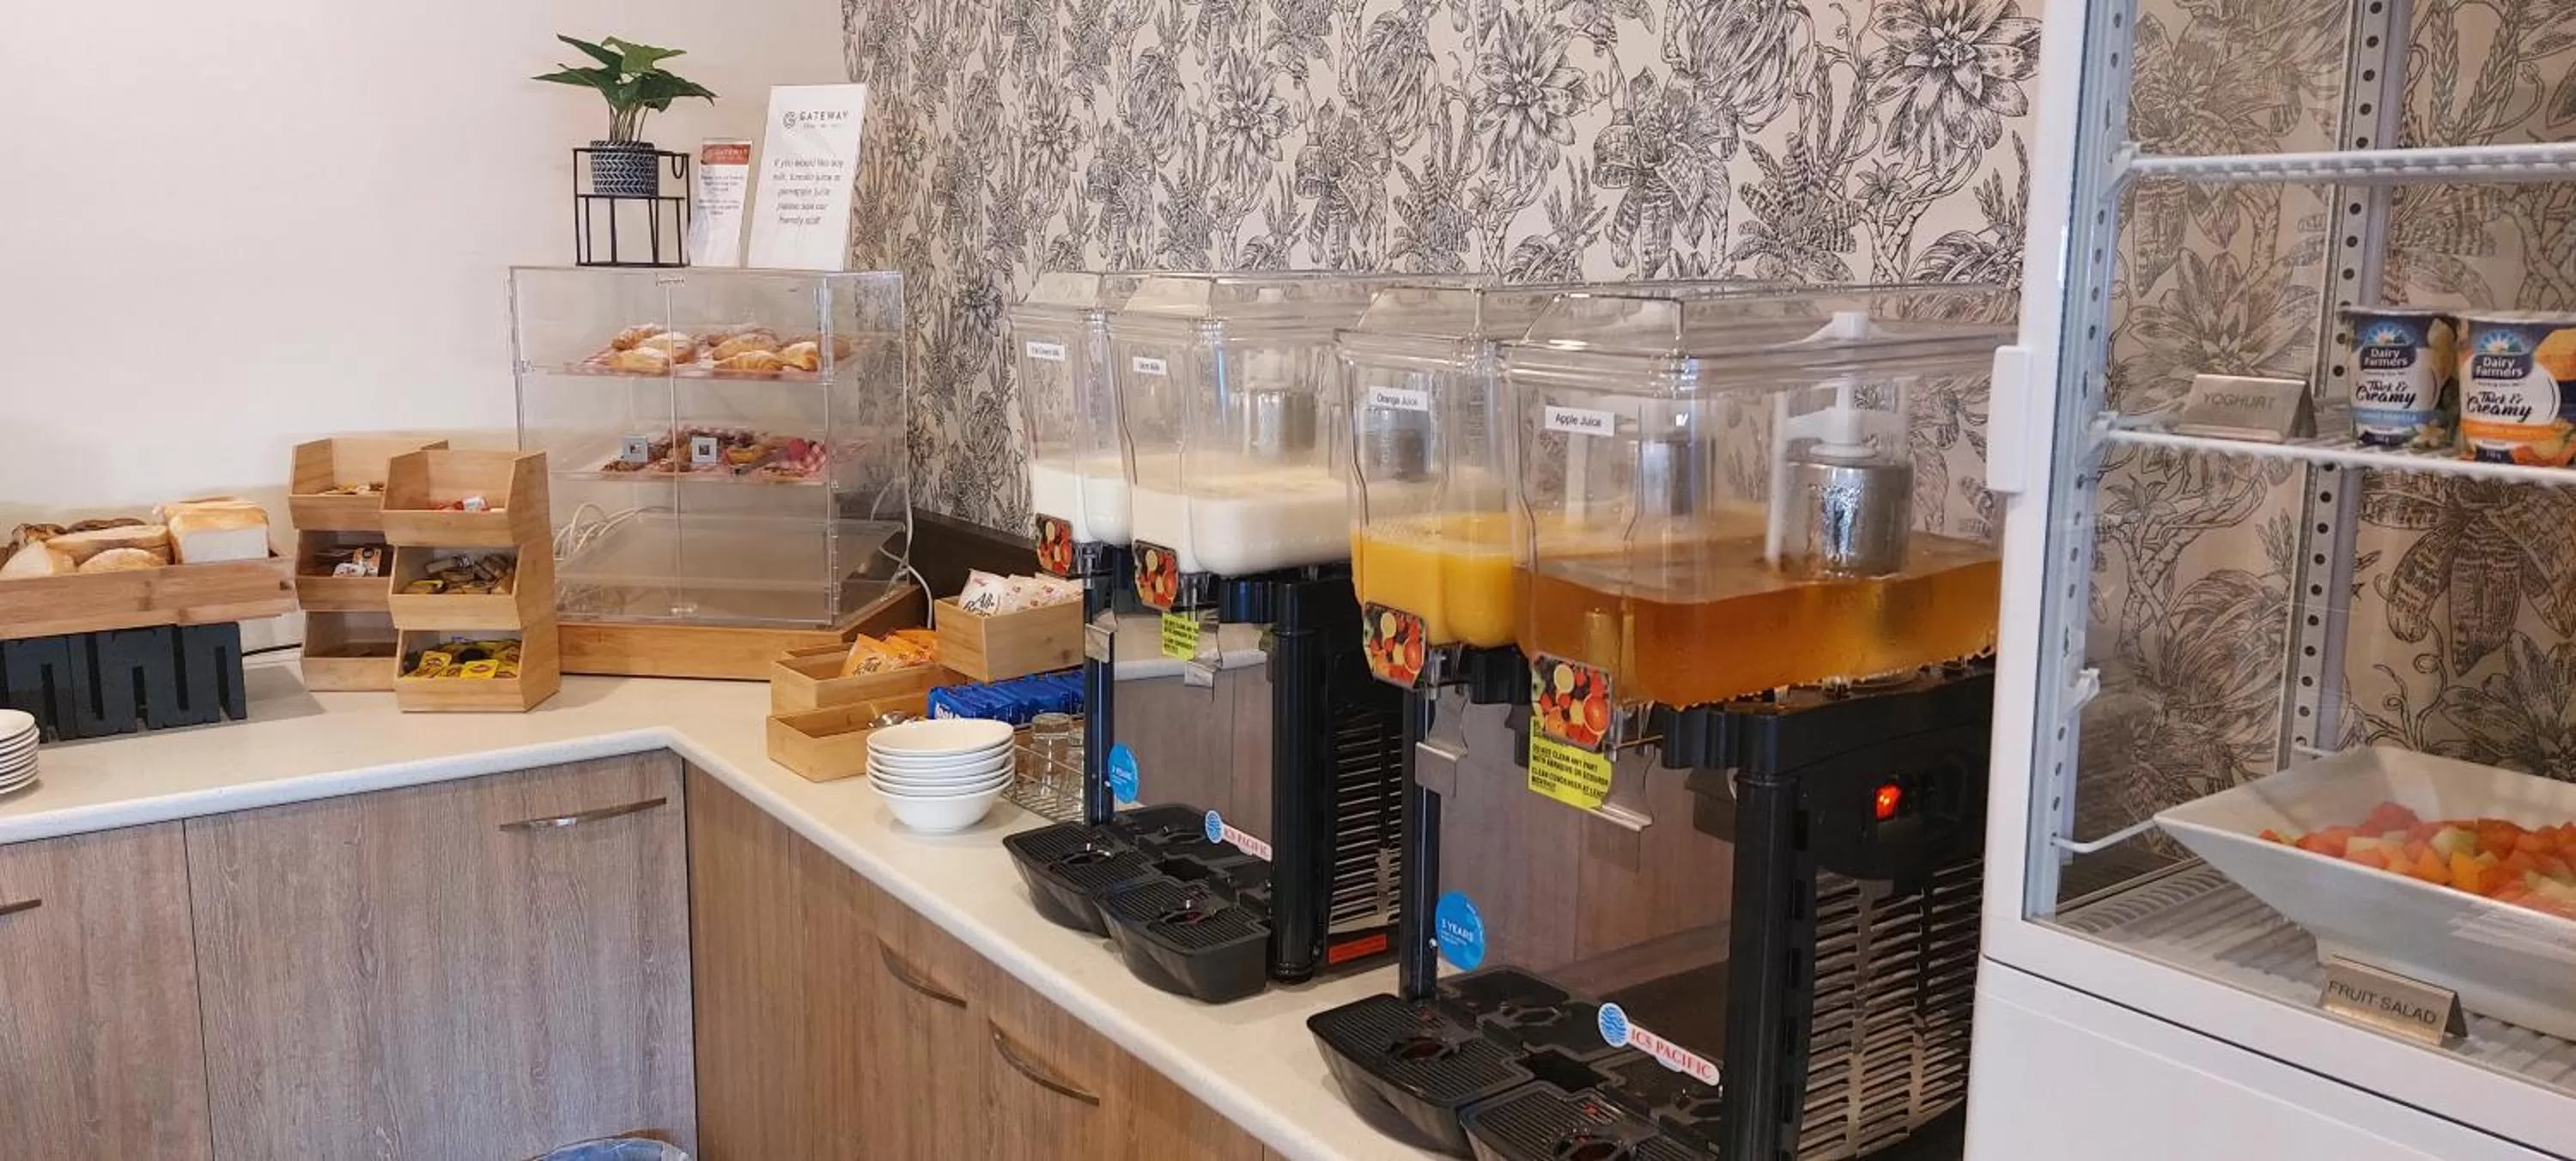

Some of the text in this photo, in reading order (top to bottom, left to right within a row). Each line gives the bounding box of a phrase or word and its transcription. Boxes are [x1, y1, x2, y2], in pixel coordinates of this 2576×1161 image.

[799, 111, 848, 121] GATEWAY
[2371, 348, 2401, 359] Dairy
[2364, 357, 2409, 367] Farmers
[2482, 356, 2515, 368] Dairy
[2476, 367, 2523, 378] Farmers
[1376, 393, 1419, 407] Orange Juice
[2202, 392, 2276, 410] YOGHURT
[2355, 385, 2417, 409] Creamy
[2466, 395, 2533, 422] Creamy
[1555, 412, 1601, 428] Apple Juice
[1552, 750, 1571, 763] CLEAN
[1532, 766, 1548, 778] CLEAN
[2328, 980, 2437, 1024] FRUIT SALAD
[1656, 1040, 1712, 1080] PACIFIC
